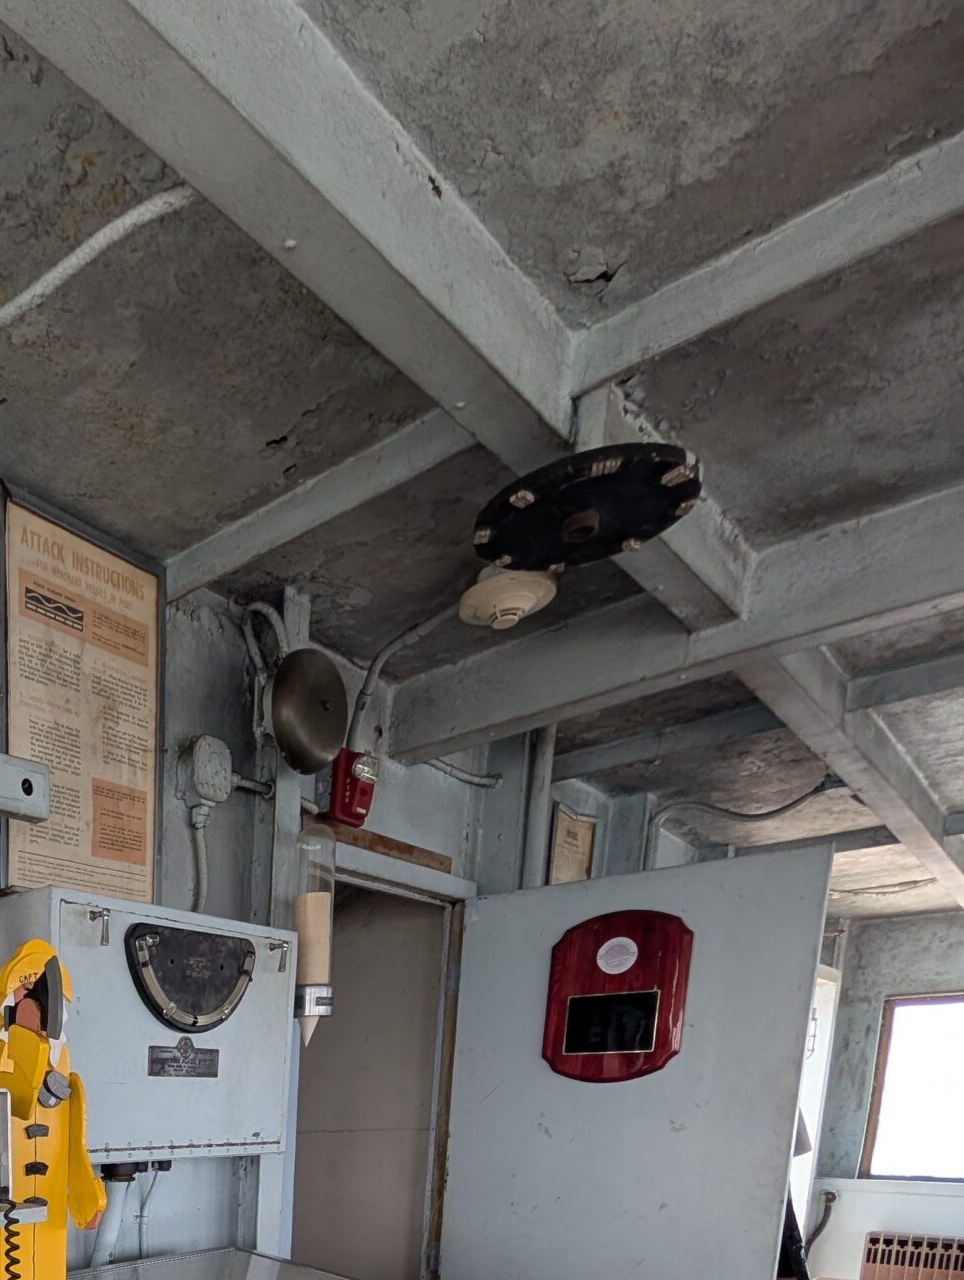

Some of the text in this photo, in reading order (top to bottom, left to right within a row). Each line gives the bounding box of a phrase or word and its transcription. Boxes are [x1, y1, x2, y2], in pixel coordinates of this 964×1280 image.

[20, 526, 65, 563] ATTACK
[72, 550, 145, 600] INSTRUCTIONS
[19, 972, 38, 983] CAPT
